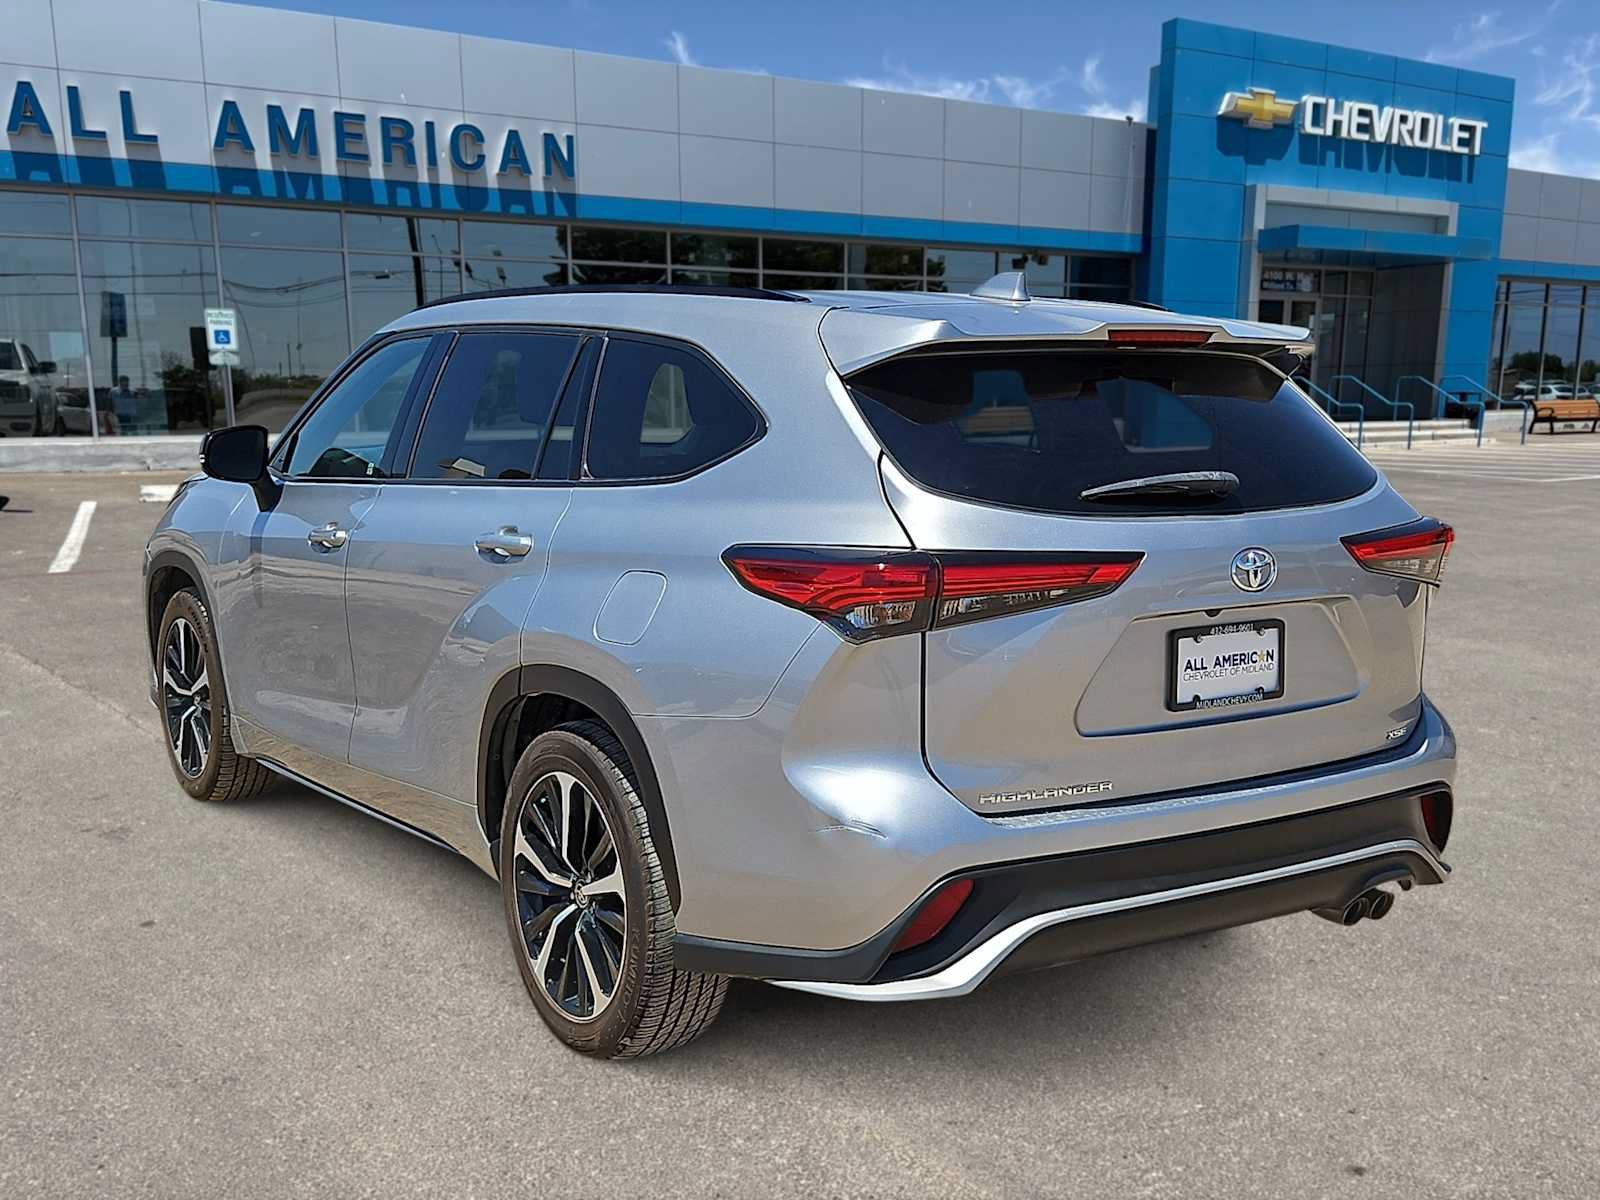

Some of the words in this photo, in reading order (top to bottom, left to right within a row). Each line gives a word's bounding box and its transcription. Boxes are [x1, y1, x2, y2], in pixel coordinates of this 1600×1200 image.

[6, 80, 159, 144] ALL
[213, 99, 576, 180] AMERICAN
[1301, 95, 1488, 155] CHEVROLET
[1183, 668, 1228, 681] CHEVROLET
[1229, 667, 1240, 675] OF
[1241, 662, 1275, 674] MIDLAND
[1184, 657, 1207, 672] ALL
[979, 781, 1113, 804] HIGHLANDER
